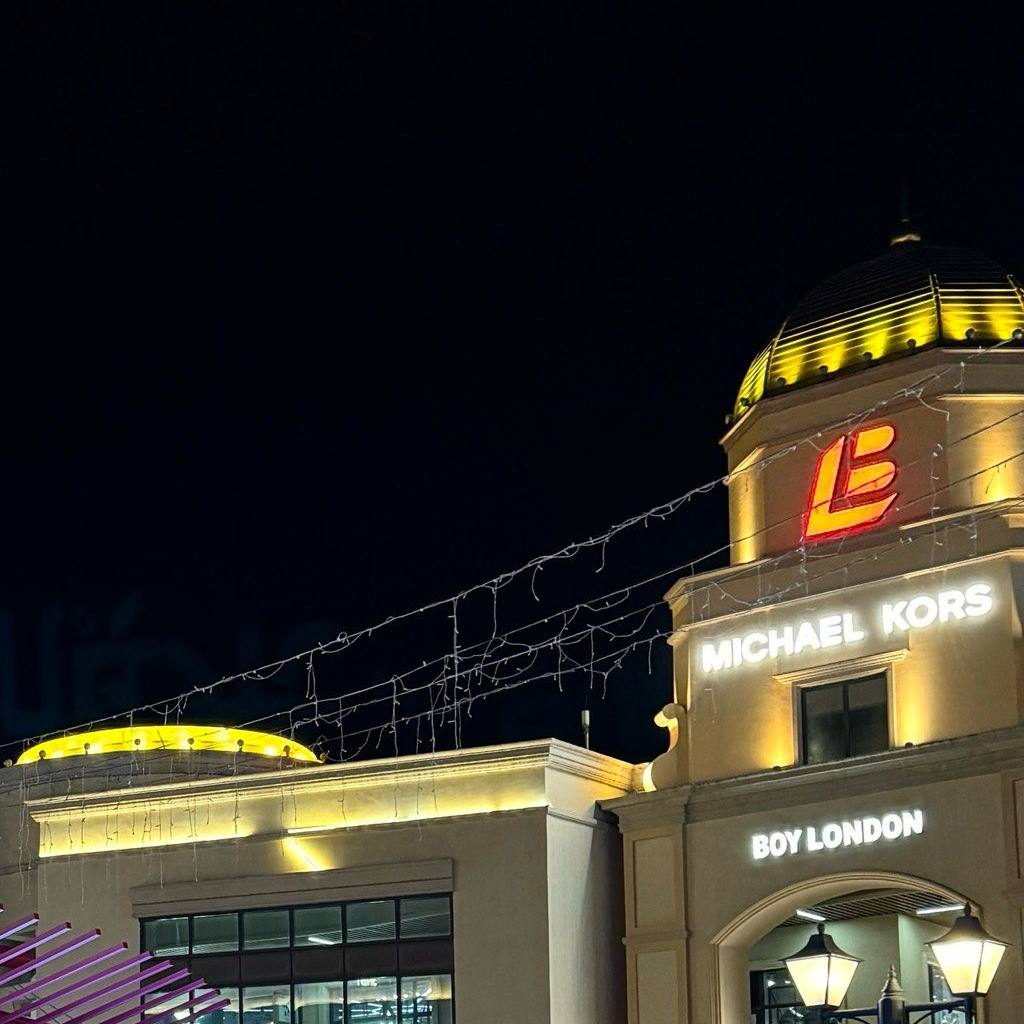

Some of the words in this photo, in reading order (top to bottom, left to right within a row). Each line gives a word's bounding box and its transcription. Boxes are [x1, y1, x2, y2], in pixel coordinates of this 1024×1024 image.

[700, 611, 866, 674] MICHAEL
[881, 582, 994, 635] KORS
[751, 828, 803, 861] BOY
[806, 809, 924, 852] LONDON
